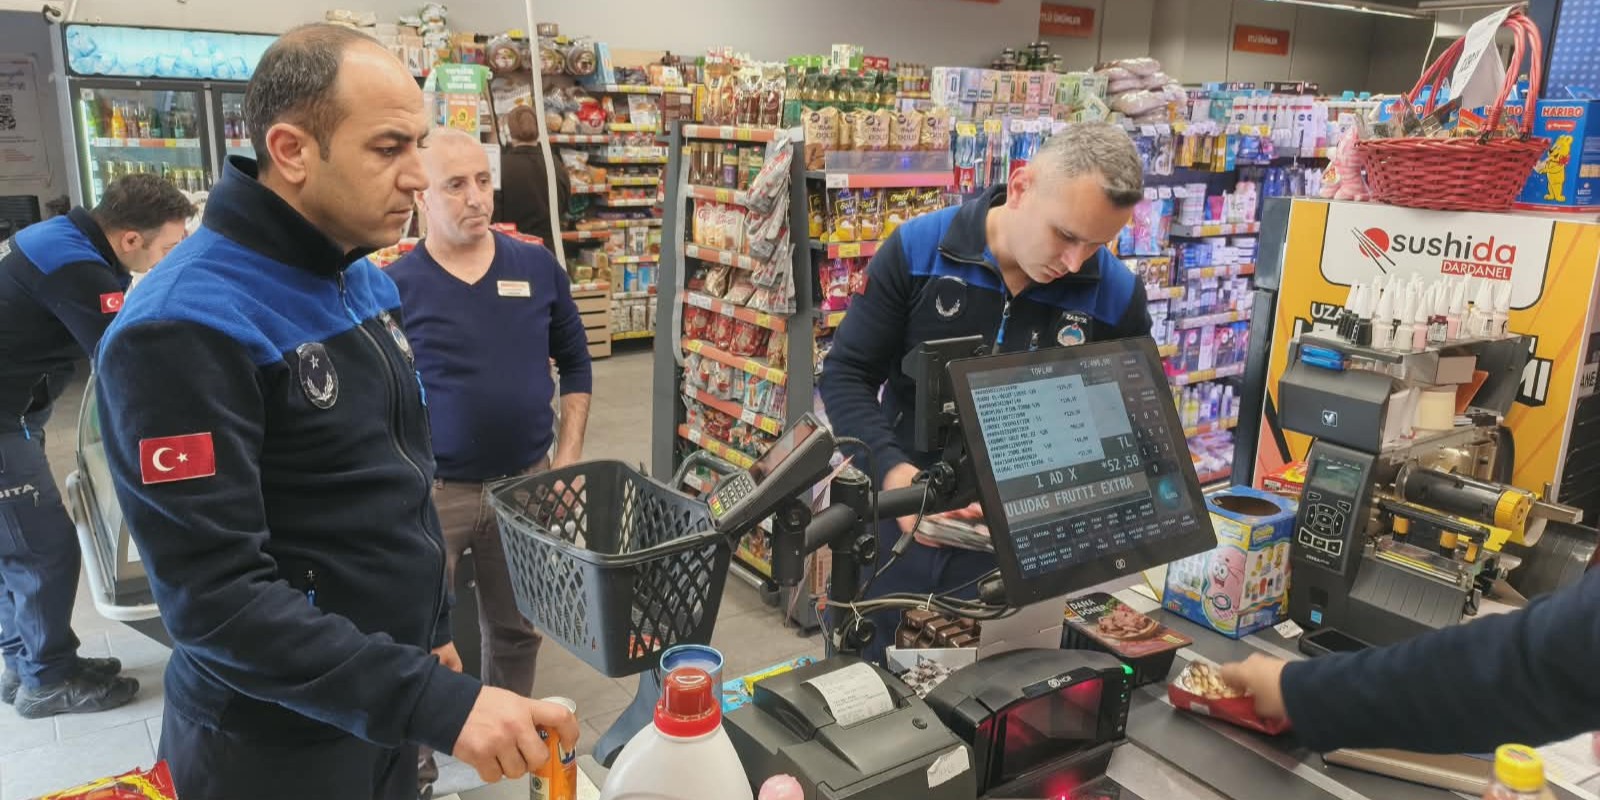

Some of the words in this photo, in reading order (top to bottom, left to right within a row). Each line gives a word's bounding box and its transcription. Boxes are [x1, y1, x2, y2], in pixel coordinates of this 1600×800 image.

[1541, 106, 1584, 117] HARIBO
[1391, 232, 1517, 265] sushida
[1443, 262, 1508, 279] DARDANEL
[1311, 302, 1345, 320] UZA
[1117, 436, 1132, 449] TL
[1035, 475, 1044, 488] 1
[1050, 472, 1064, 486] AD
[1069, 467, 1078, 481] X
[1004, 496, 1050, 517] ULUDAG
[1055, 485, 1097, 505] FRUTTI
[1100, 475, 1135, 495] EXTRA
[1070, 599, 1096, 611] DANA
